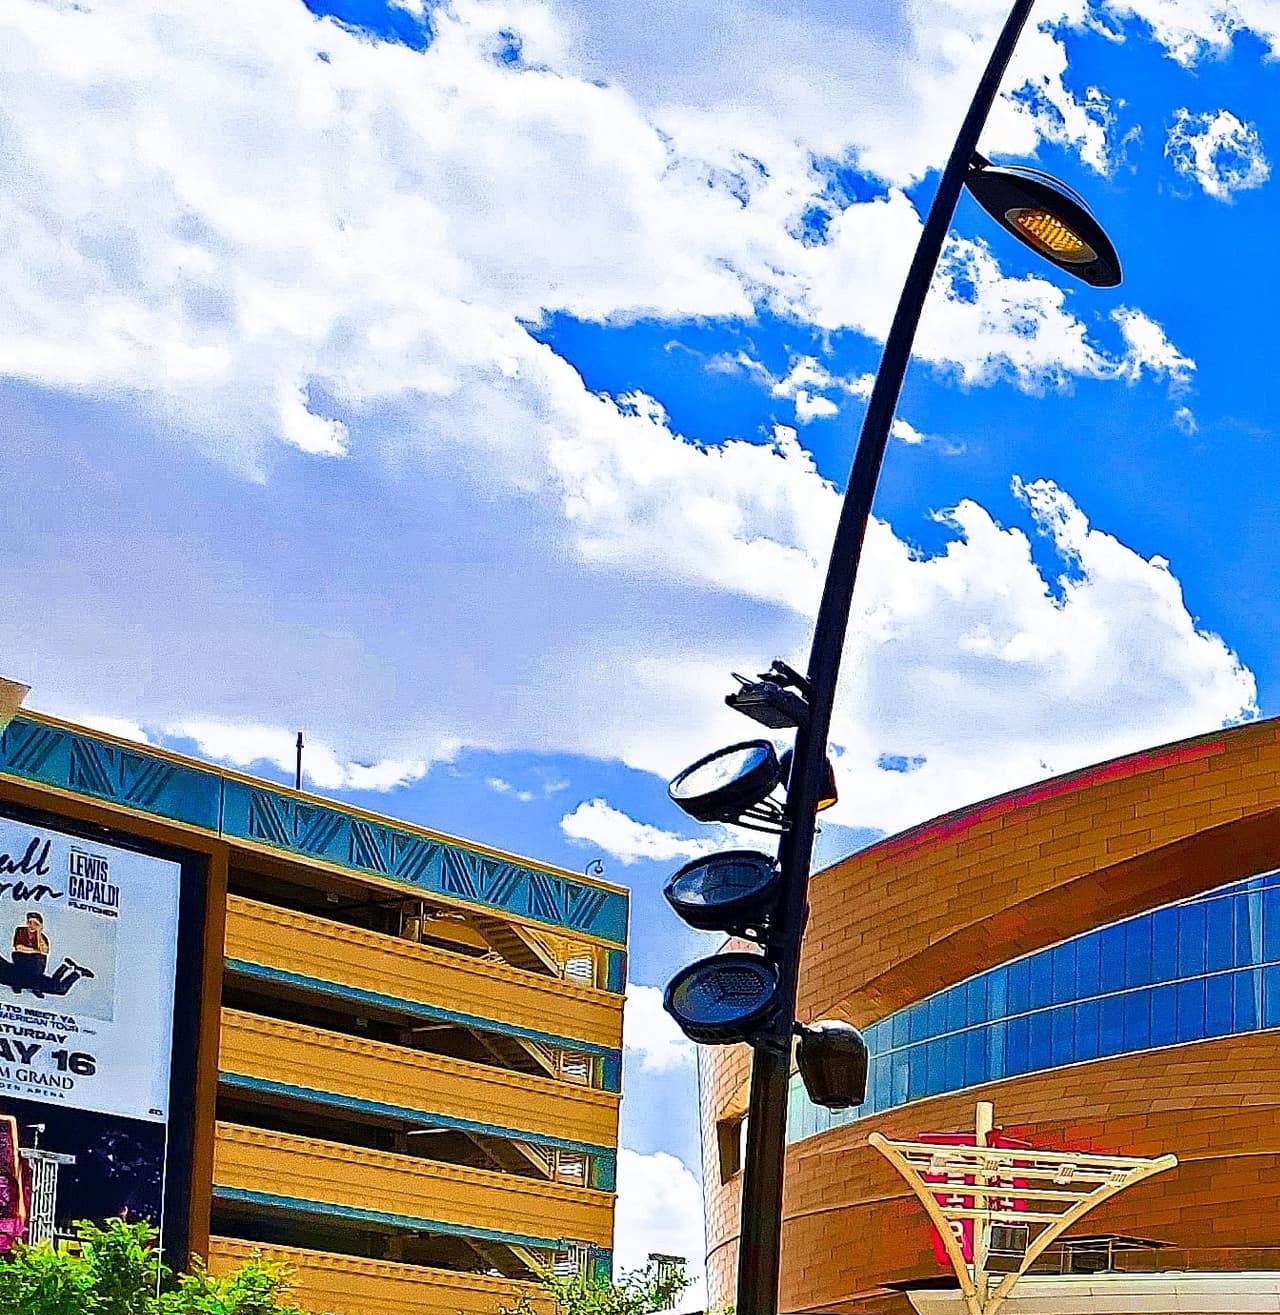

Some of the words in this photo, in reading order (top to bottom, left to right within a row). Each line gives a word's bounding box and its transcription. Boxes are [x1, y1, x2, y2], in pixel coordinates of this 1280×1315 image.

[70, 853, 108, 882] LEWIS
[69, 876, 119, 908] CAPALDI
[51, 1049, 96, 1076] 16
[16, 1068, 74, 1089] GRAND
